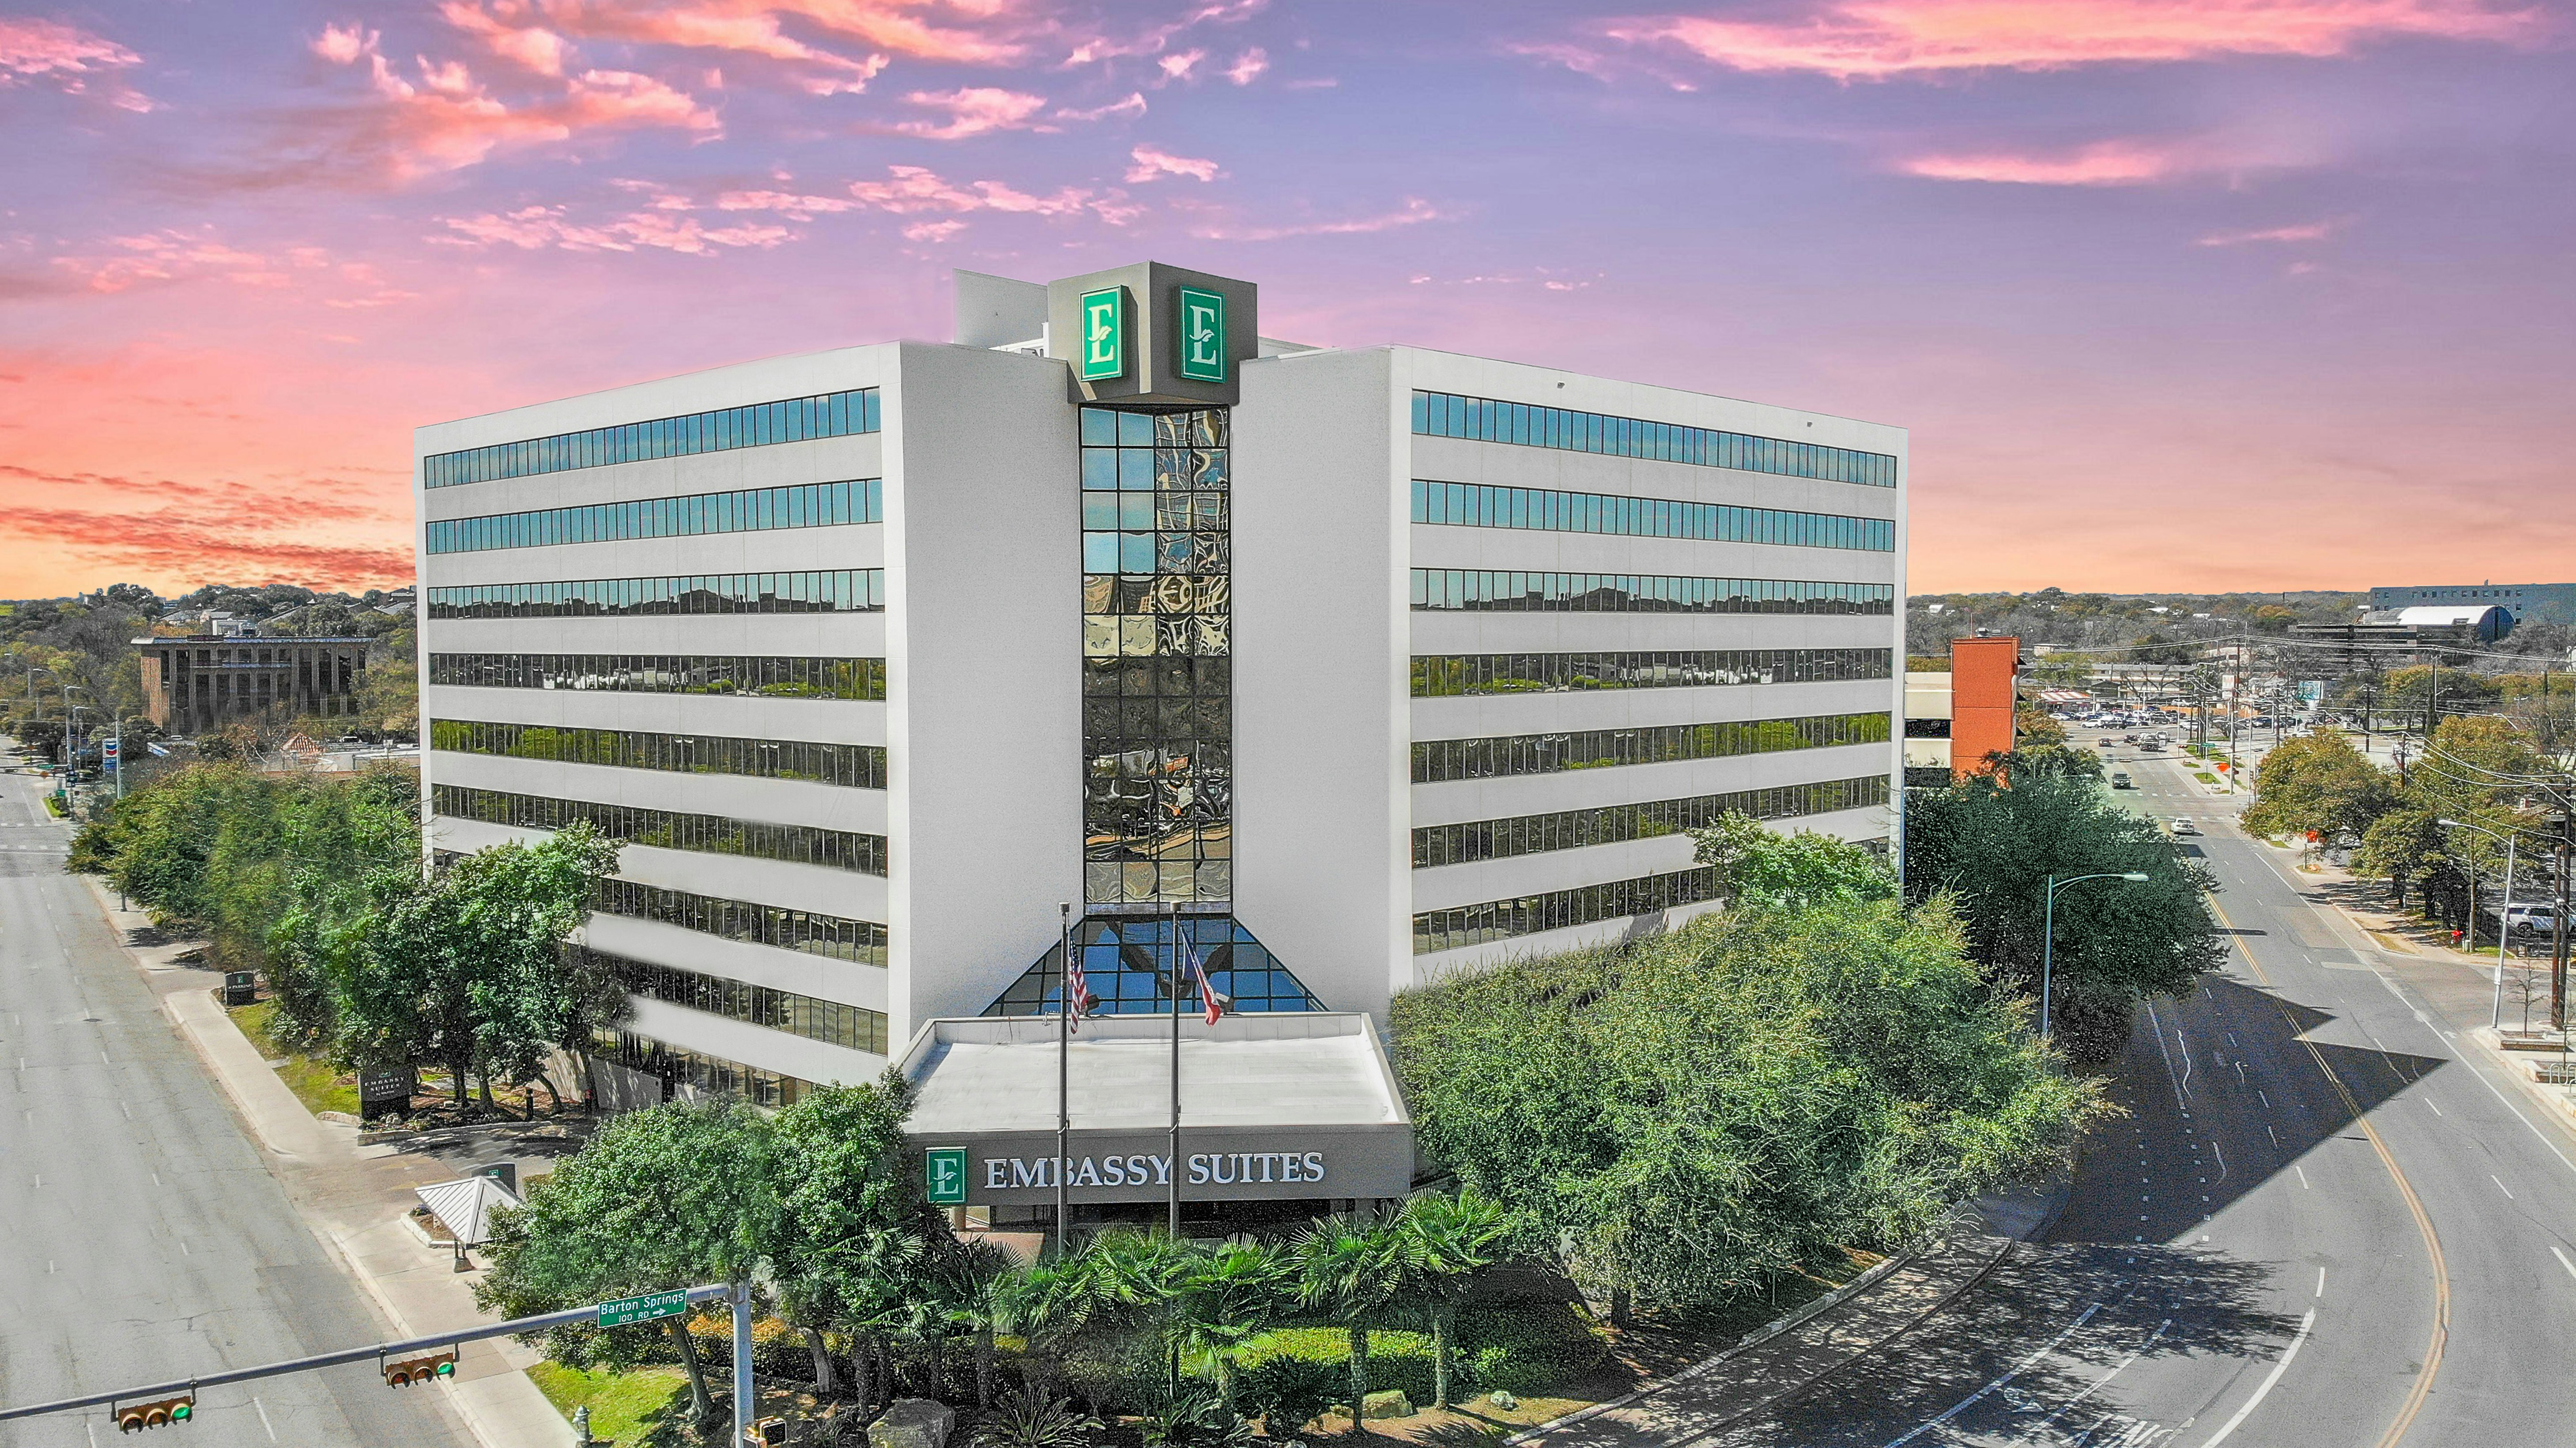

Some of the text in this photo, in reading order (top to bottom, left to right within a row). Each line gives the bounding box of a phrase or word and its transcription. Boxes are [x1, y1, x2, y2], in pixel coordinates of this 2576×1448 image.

[1088, 303, 1115, 364] E
[1189, 305, 1216, 366] E
[933, 1158, 959, 1195] E
[984, 1152, 1324, 1188] EMBASSY SUITES
[601, 1292, 684, 1315] Barton Springs
[619, 1311, 649, 1323] 100 RD
